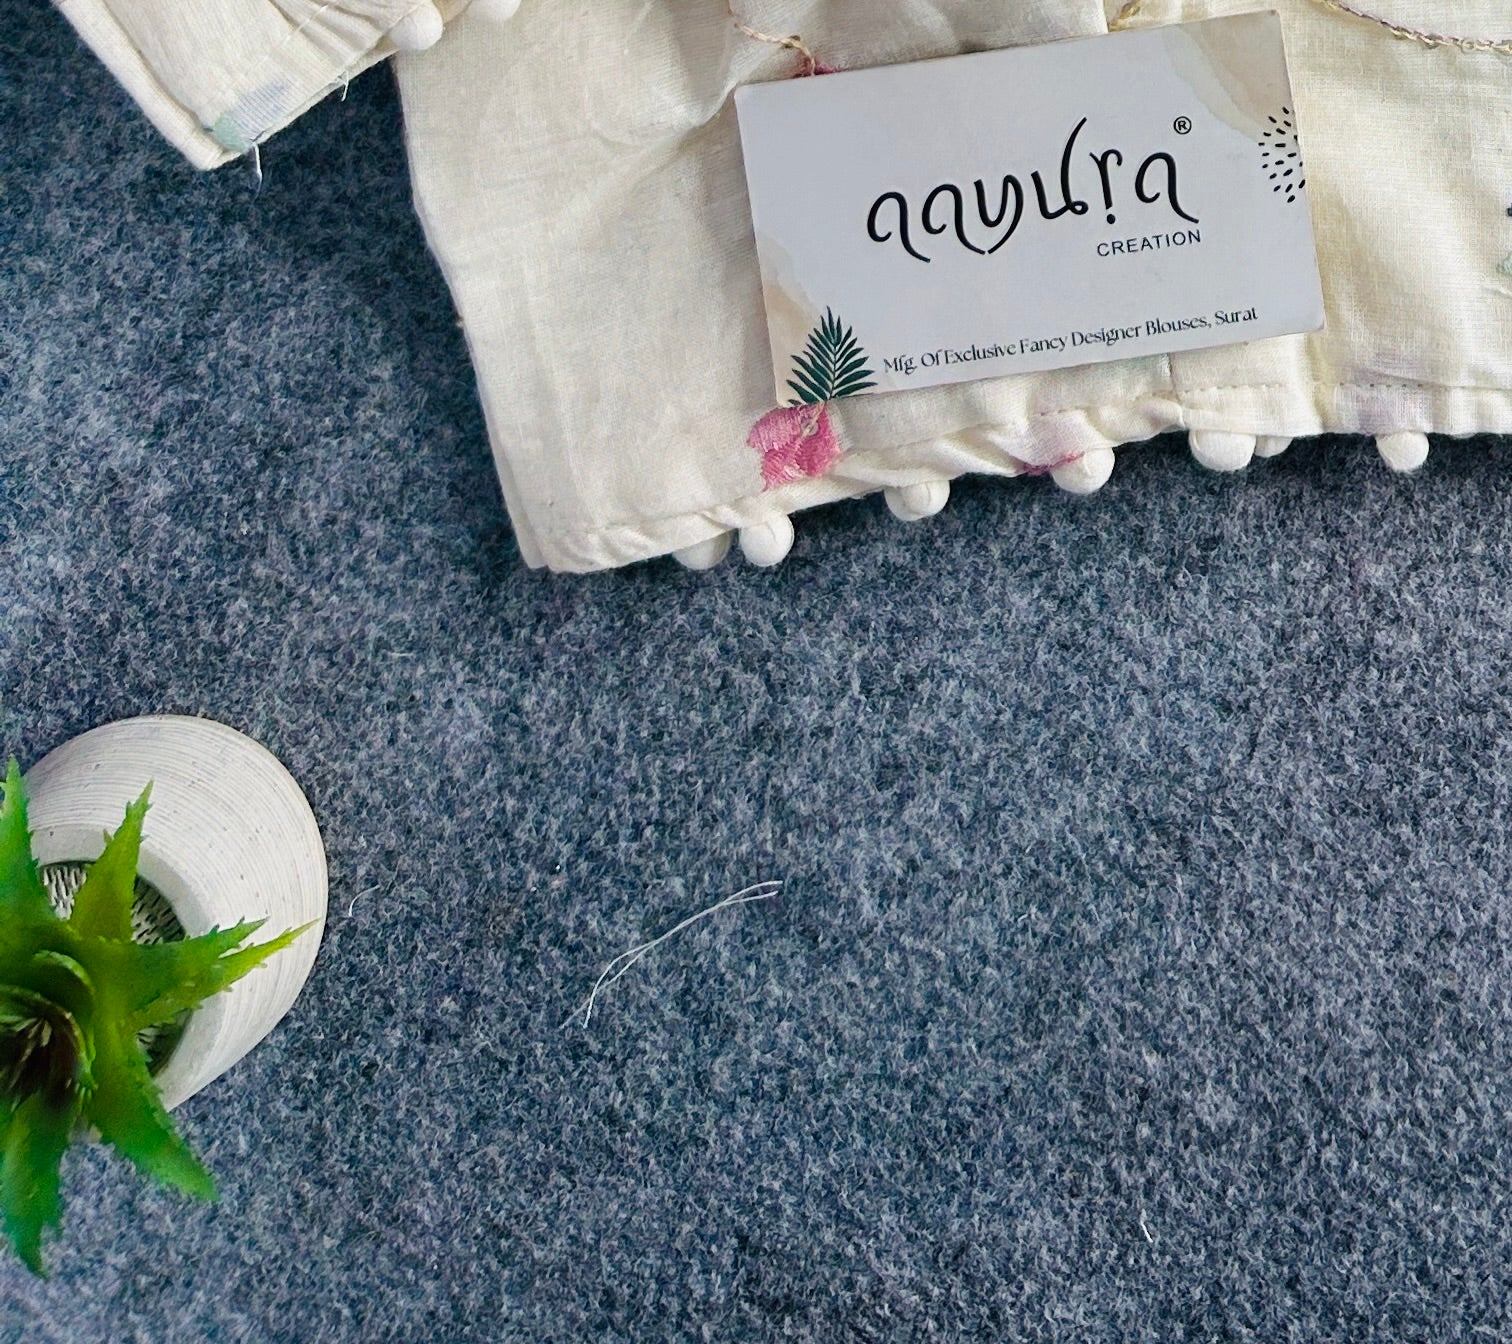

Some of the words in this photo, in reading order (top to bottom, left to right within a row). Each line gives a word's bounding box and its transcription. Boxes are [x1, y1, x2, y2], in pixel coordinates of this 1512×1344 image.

[1096, 229, 1201, 257] CREATION
[920, 348, 943, 368] Of
[944, 344, 1017, 365] Exclusive
[1019, 336, 1068, 354] Fancy
[1072, 325, 1142, 346] Designer
[1146, 317, 1212, 337] Blouses,
[1214, 307, 1258, 325] Surat
